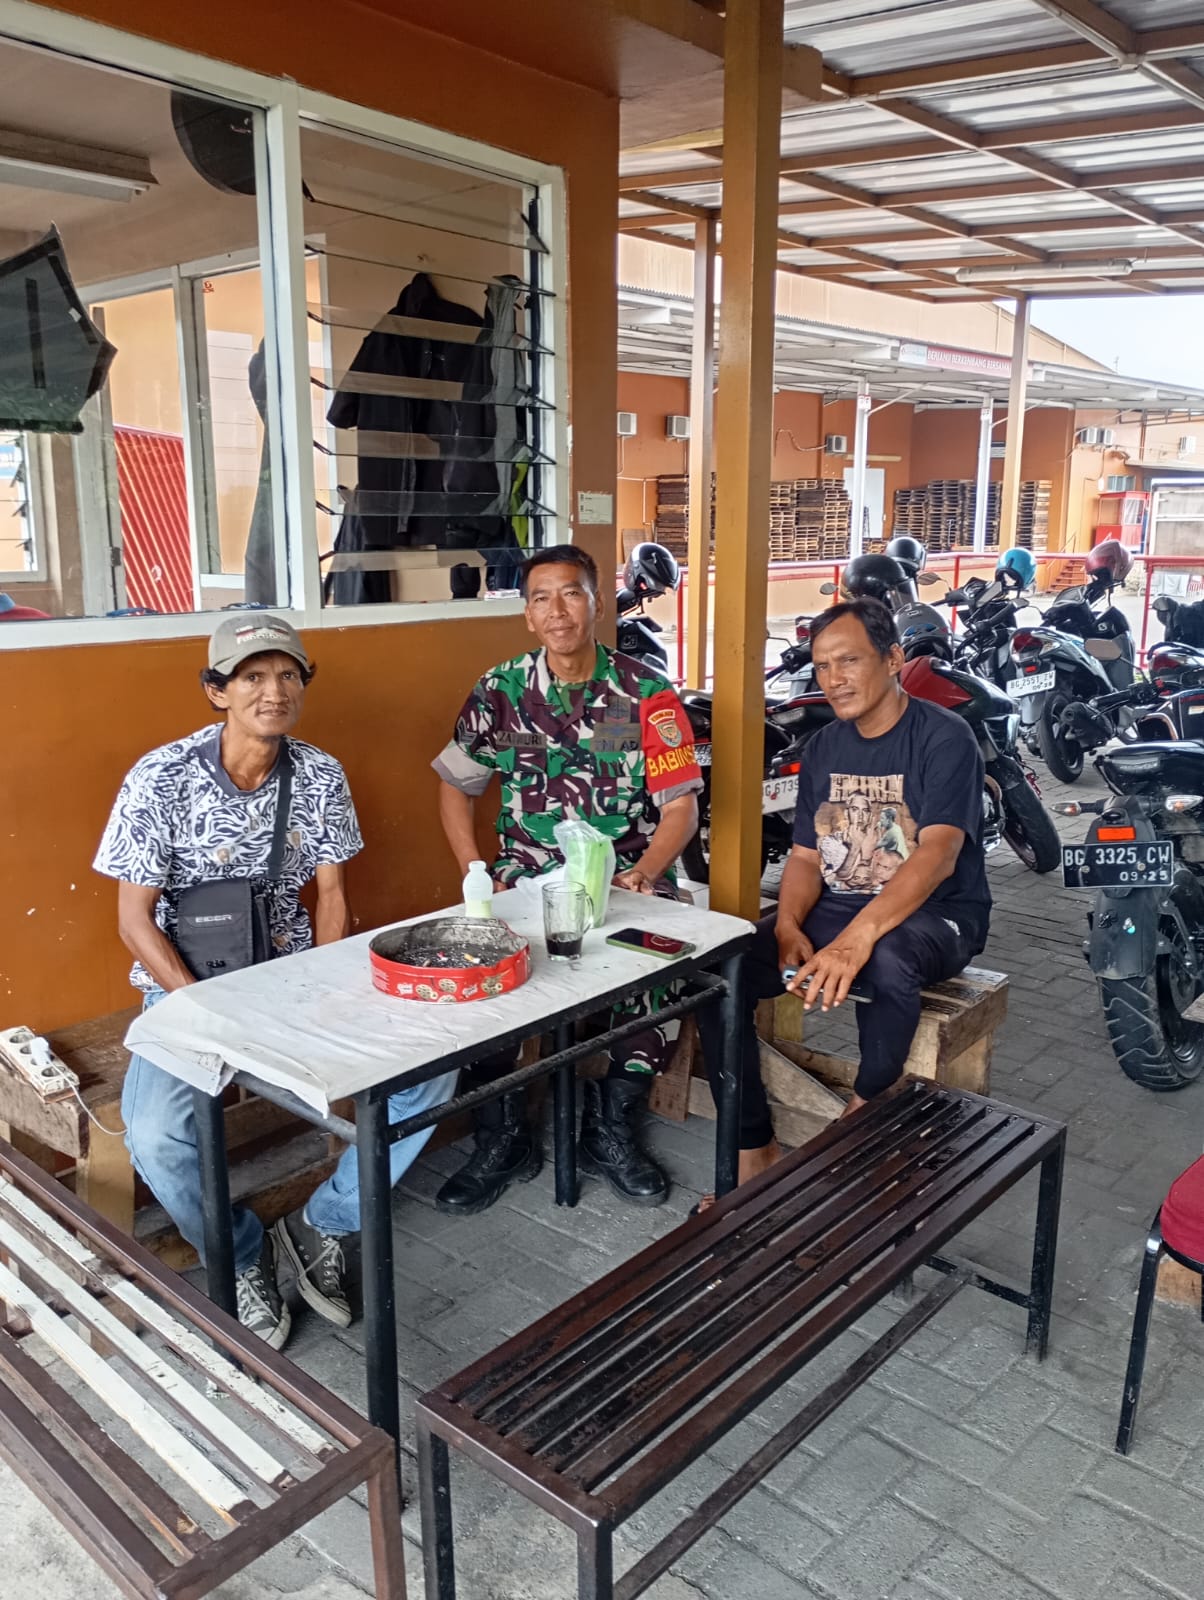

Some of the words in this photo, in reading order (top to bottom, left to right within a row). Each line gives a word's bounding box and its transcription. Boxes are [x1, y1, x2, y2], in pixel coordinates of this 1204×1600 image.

[1064, 849, 1085, 866] BG
[1095, 847, 1138, 865] 3325
[1146, 846, 1170, 863] CW
